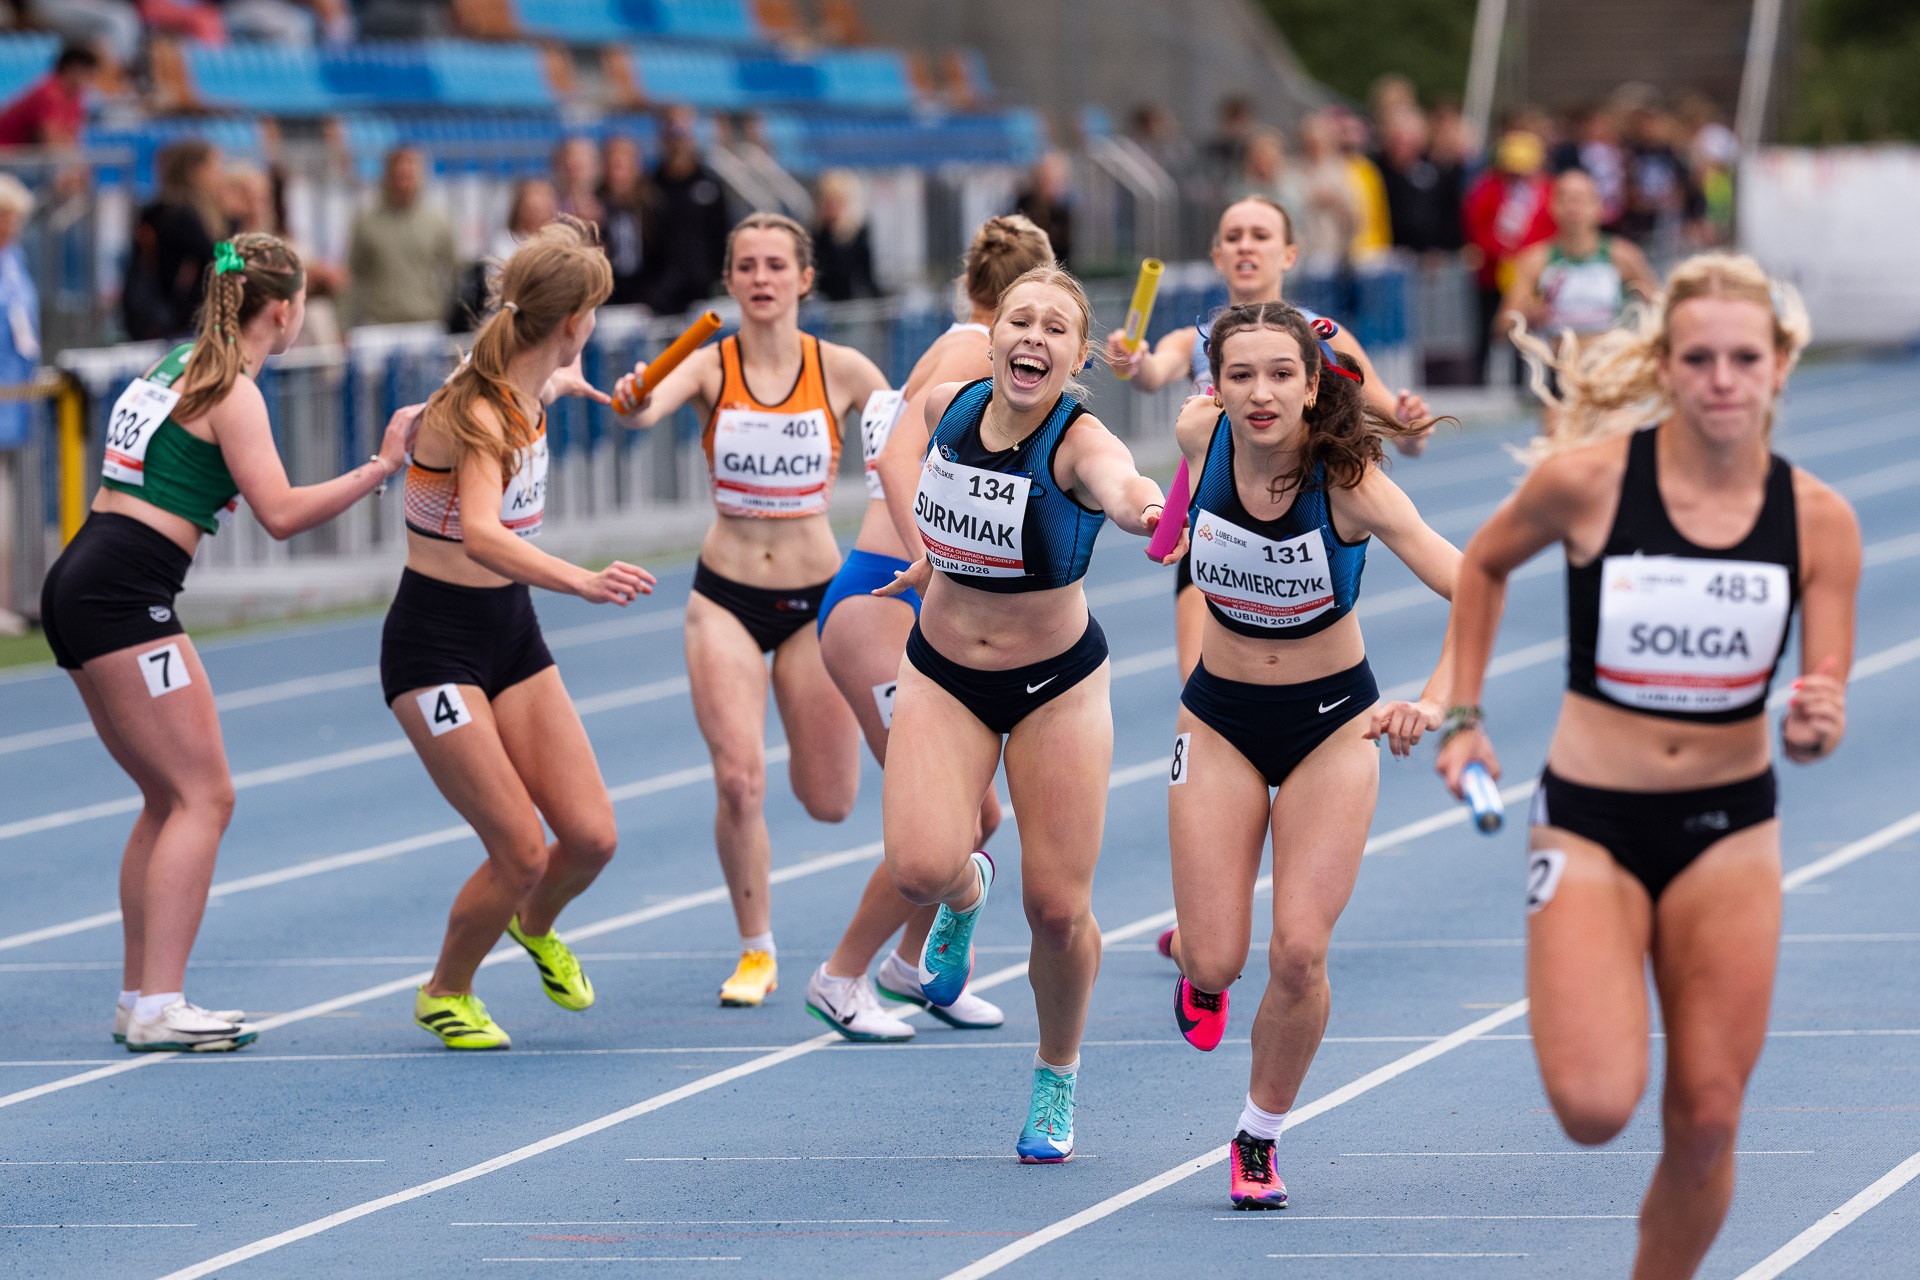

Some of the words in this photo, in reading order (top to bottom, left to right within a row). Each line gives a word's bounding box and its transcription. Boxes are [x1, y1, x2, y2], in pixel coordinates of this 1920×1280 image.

[782, 420, 819, 438] 401
[723, 453, 822, 476] GALACH
[968, 475, 1015, 505] 134
[915, 491, 1015, 549] SURMIAK
[1215, 529, 1248, 548] LUBELSKIE
[1262, 542, 1313, 564] 131
[961, 564, 990, 575] 2026
[1196, 560, 1326, 598] KAŹMIERCZYK
[1706, 573, 1770, 603] 483
[1229, 610, 1267, 625] LUBLIN
[1270, 616, 1301, 626] 2026
[1630, 623, 1750, 658] SOLGA
[149, 651, 170, 688] 7
[434, 690, 459, 725] 4
[1171, 738, 1183, 781] 8
[1529, 857, 1551, 905] 2
